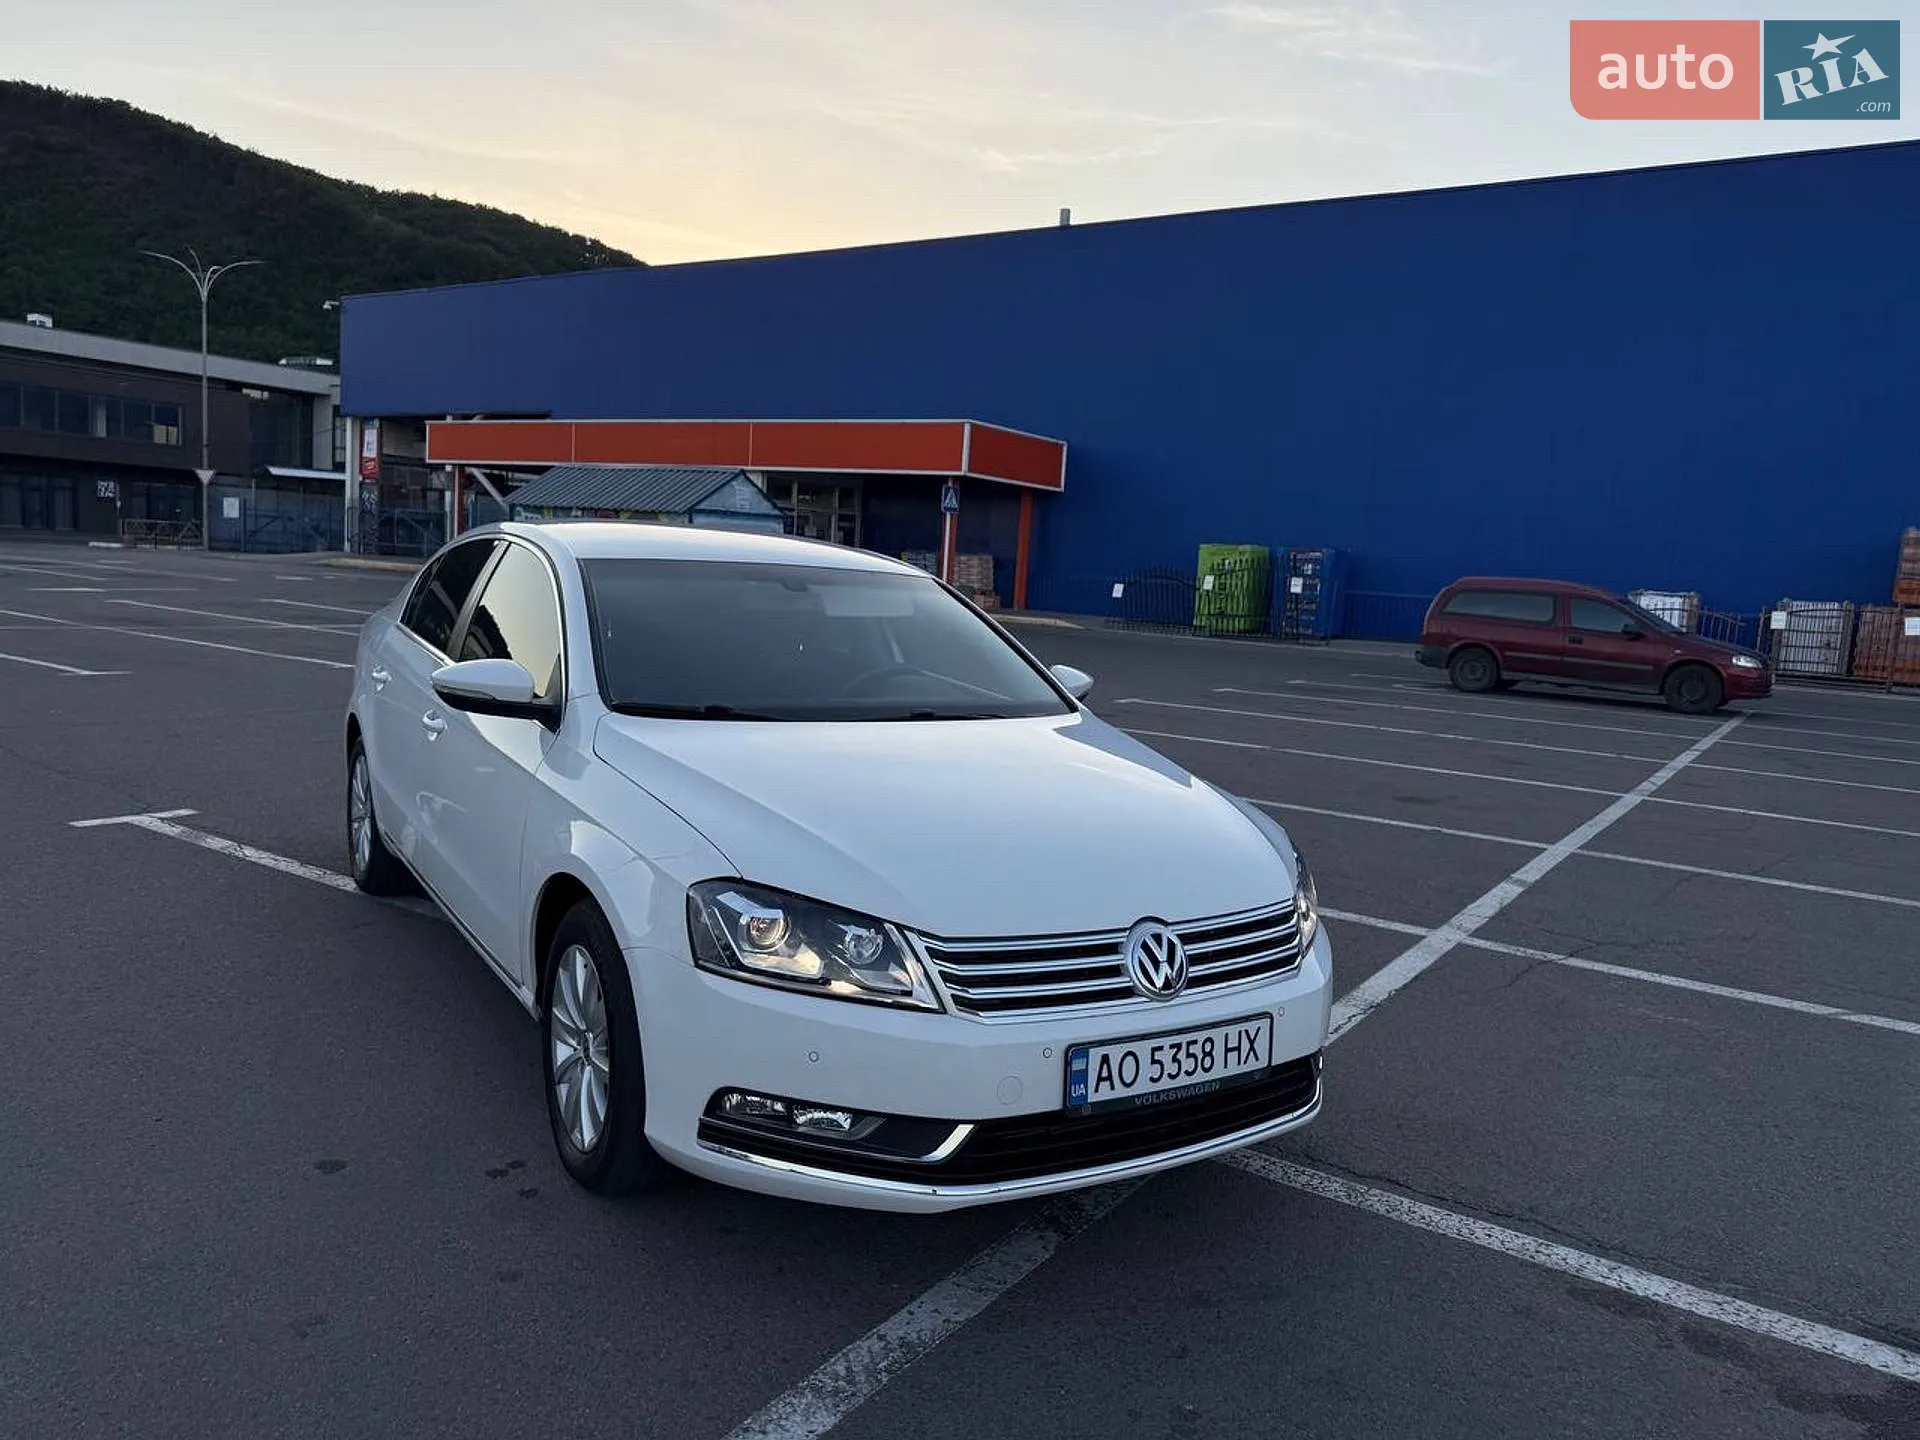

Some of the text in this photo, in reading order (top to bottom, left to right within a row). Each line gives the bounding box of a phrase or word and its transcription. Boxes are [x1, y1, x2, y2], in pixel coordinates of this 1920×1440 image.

[1071, 1026, 1262, 1098] UA AO 5358 HX
[1133, 1081, 1222, 1106] VOLKSWAGEN
